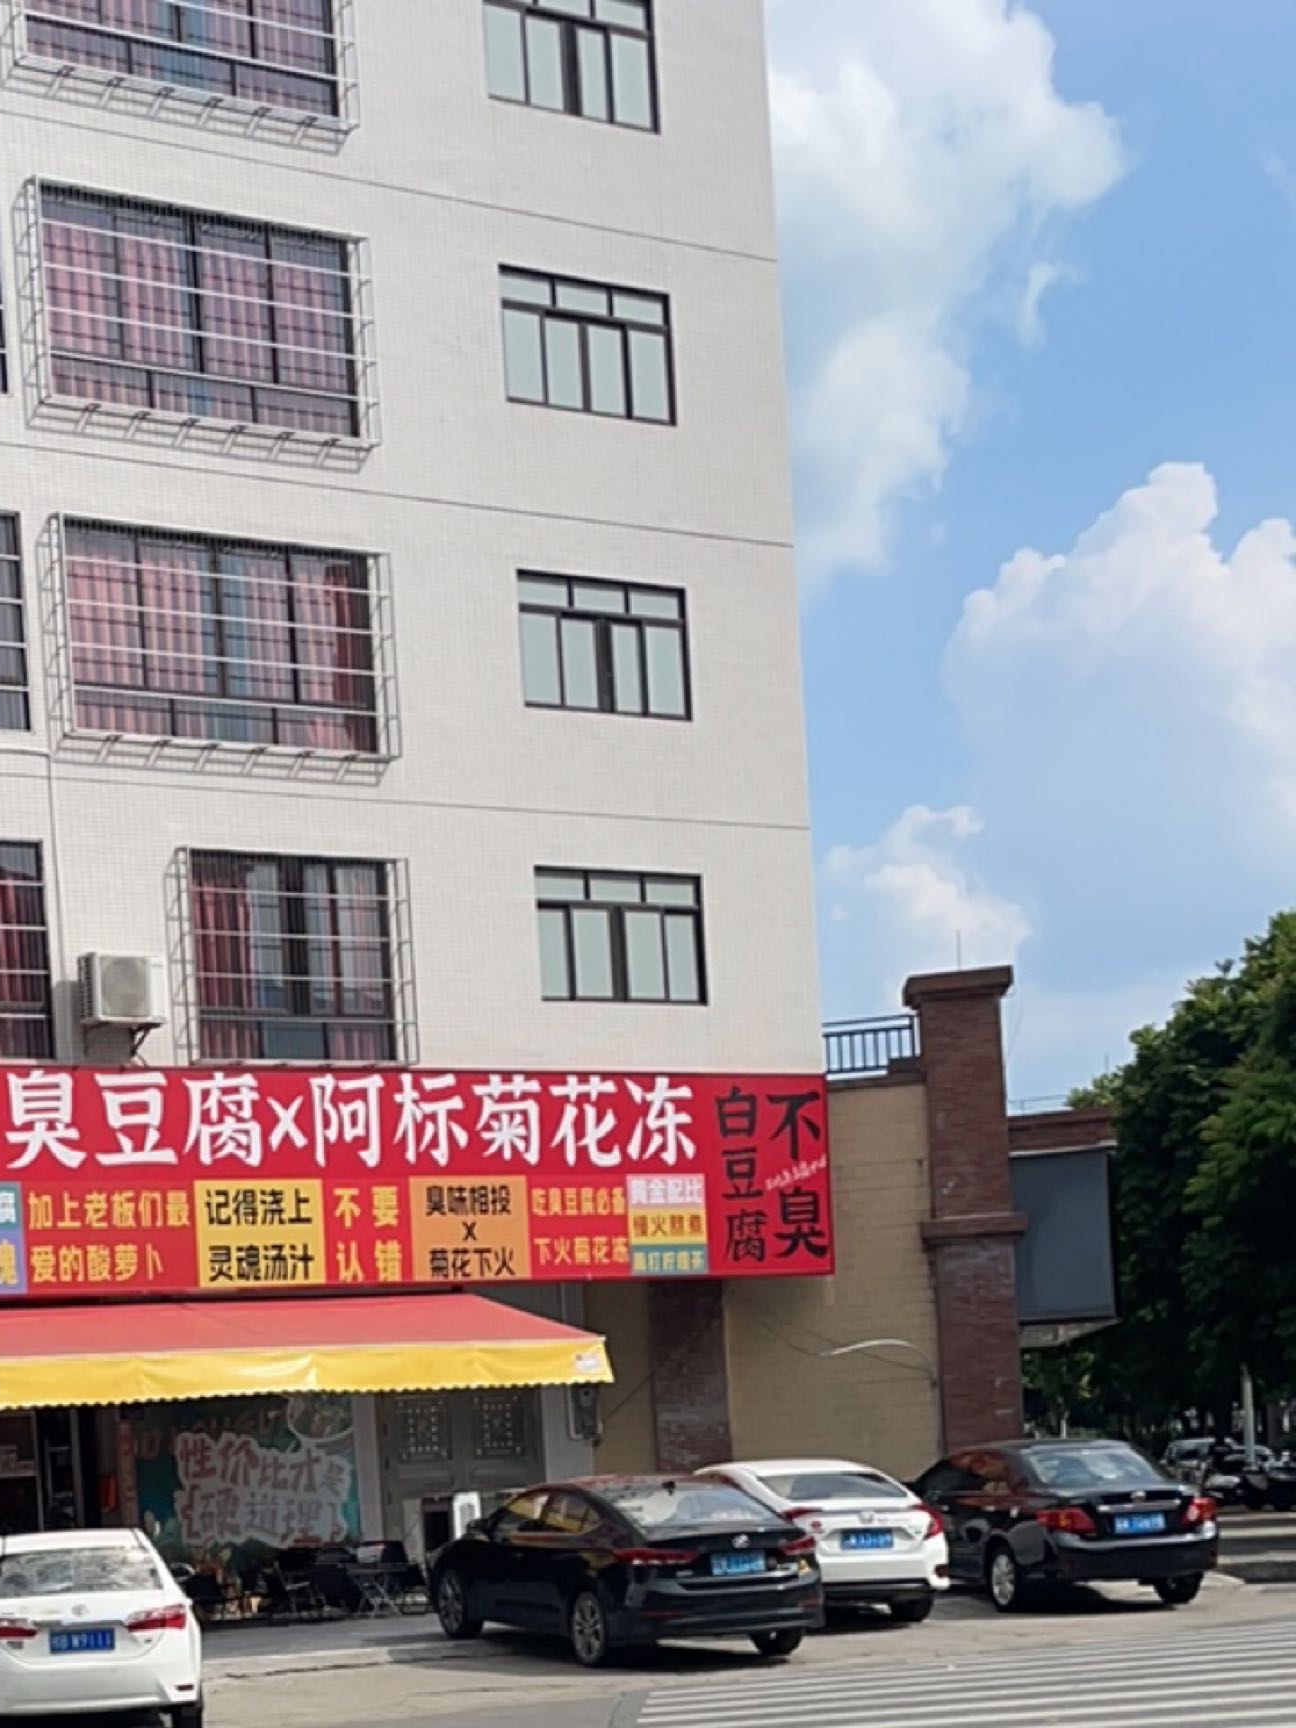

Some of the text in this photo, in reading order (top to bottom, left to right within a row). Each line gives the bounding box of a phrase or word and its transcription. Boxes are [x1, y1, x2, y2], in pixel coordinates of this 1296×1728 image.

[206, 1189, 313, 1226] 记得浇上
[425, 1185, 511, 1216] 臭味相投
[31, 1244, 164, 1283] 爱的酸萝卜
[208, 1244, 315, 1282] 灵魂汤汁
[429, 1247, 516, 1277] 菊花下火
